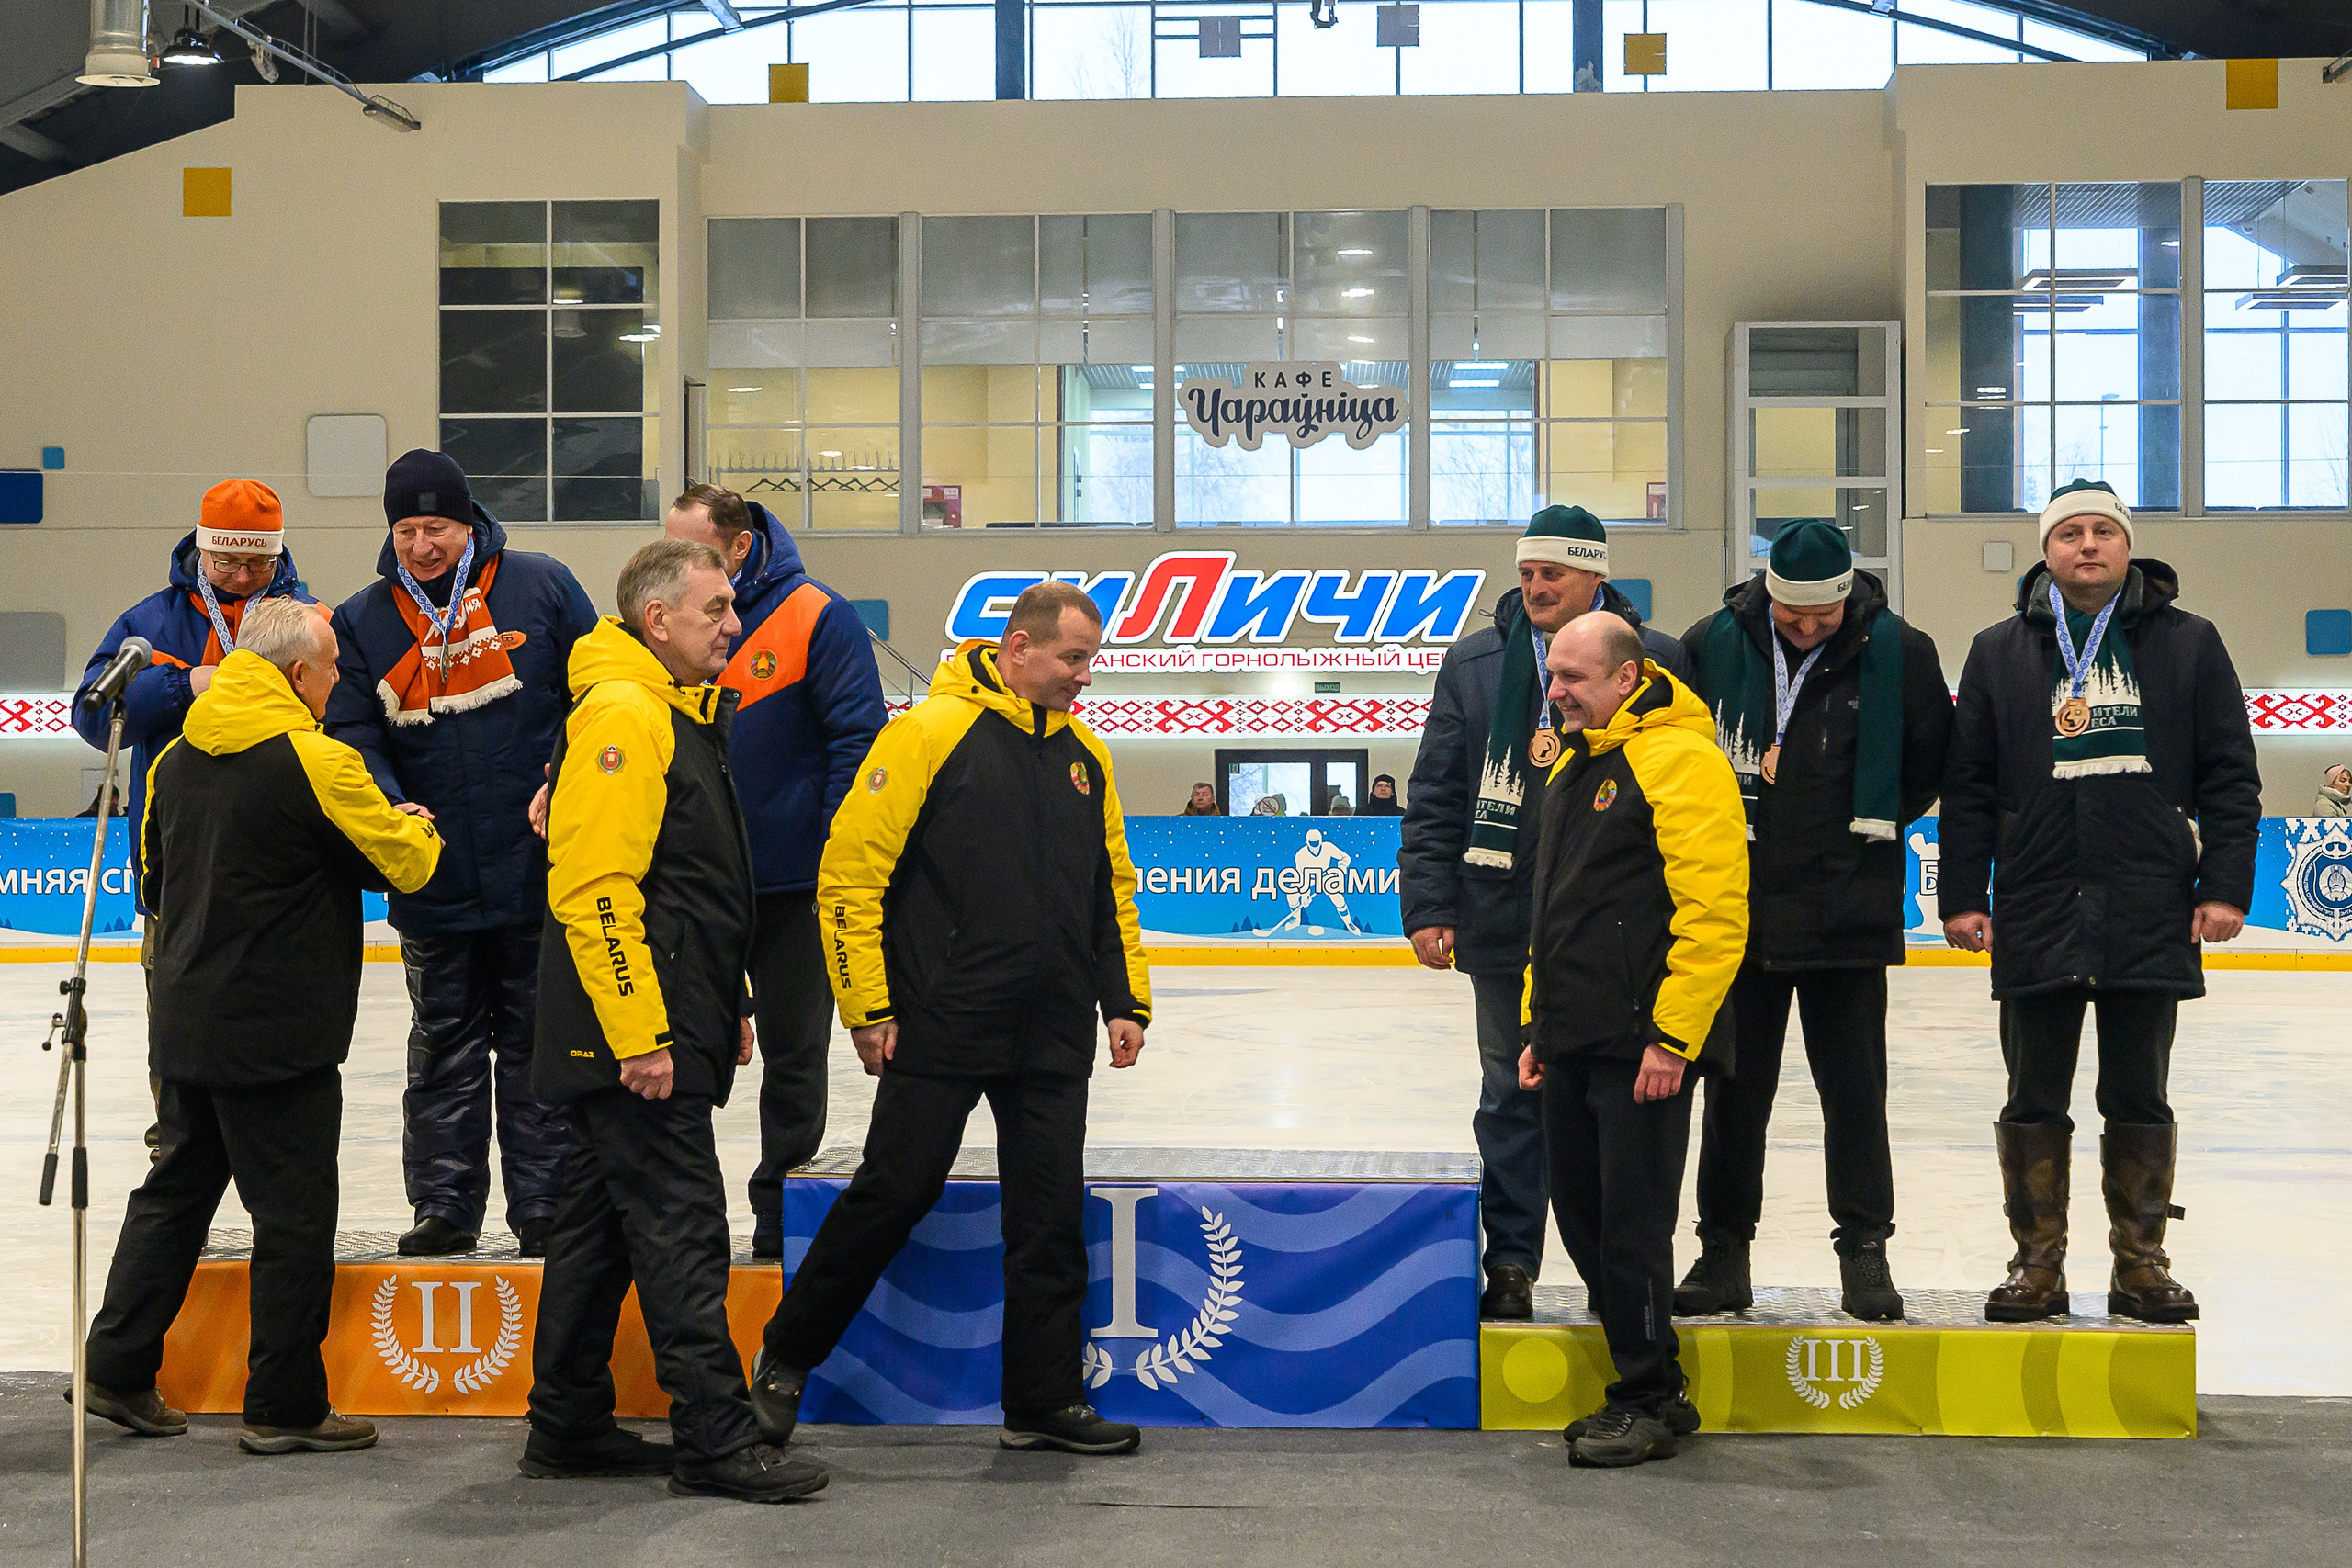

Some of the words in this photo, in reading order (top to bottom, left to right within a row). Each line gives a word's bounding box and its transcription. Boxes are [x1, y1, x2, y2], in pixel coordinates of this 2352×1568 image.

[1254, 371, 1332, 389] КАФЕ
[1188, 387, 1400, 441] Чараўніца
[211, 536, 267, 547] БЕЛАРУСЬ
[1202, 649, 1400, 668] ГОРНОЛЫЖНЫЙ
[2090, 716, 2117, 728] ЕСА
[1250, 866, 1400, 901] делами
[596, 896, 635, 998] BELARUS
[833, 905, 853, 989] BELARUS
[570, 1050, 594, 1058] ORAZ
[411, 1281, 482, 1353] II
[1801, 1339, 1869, 1382] III
